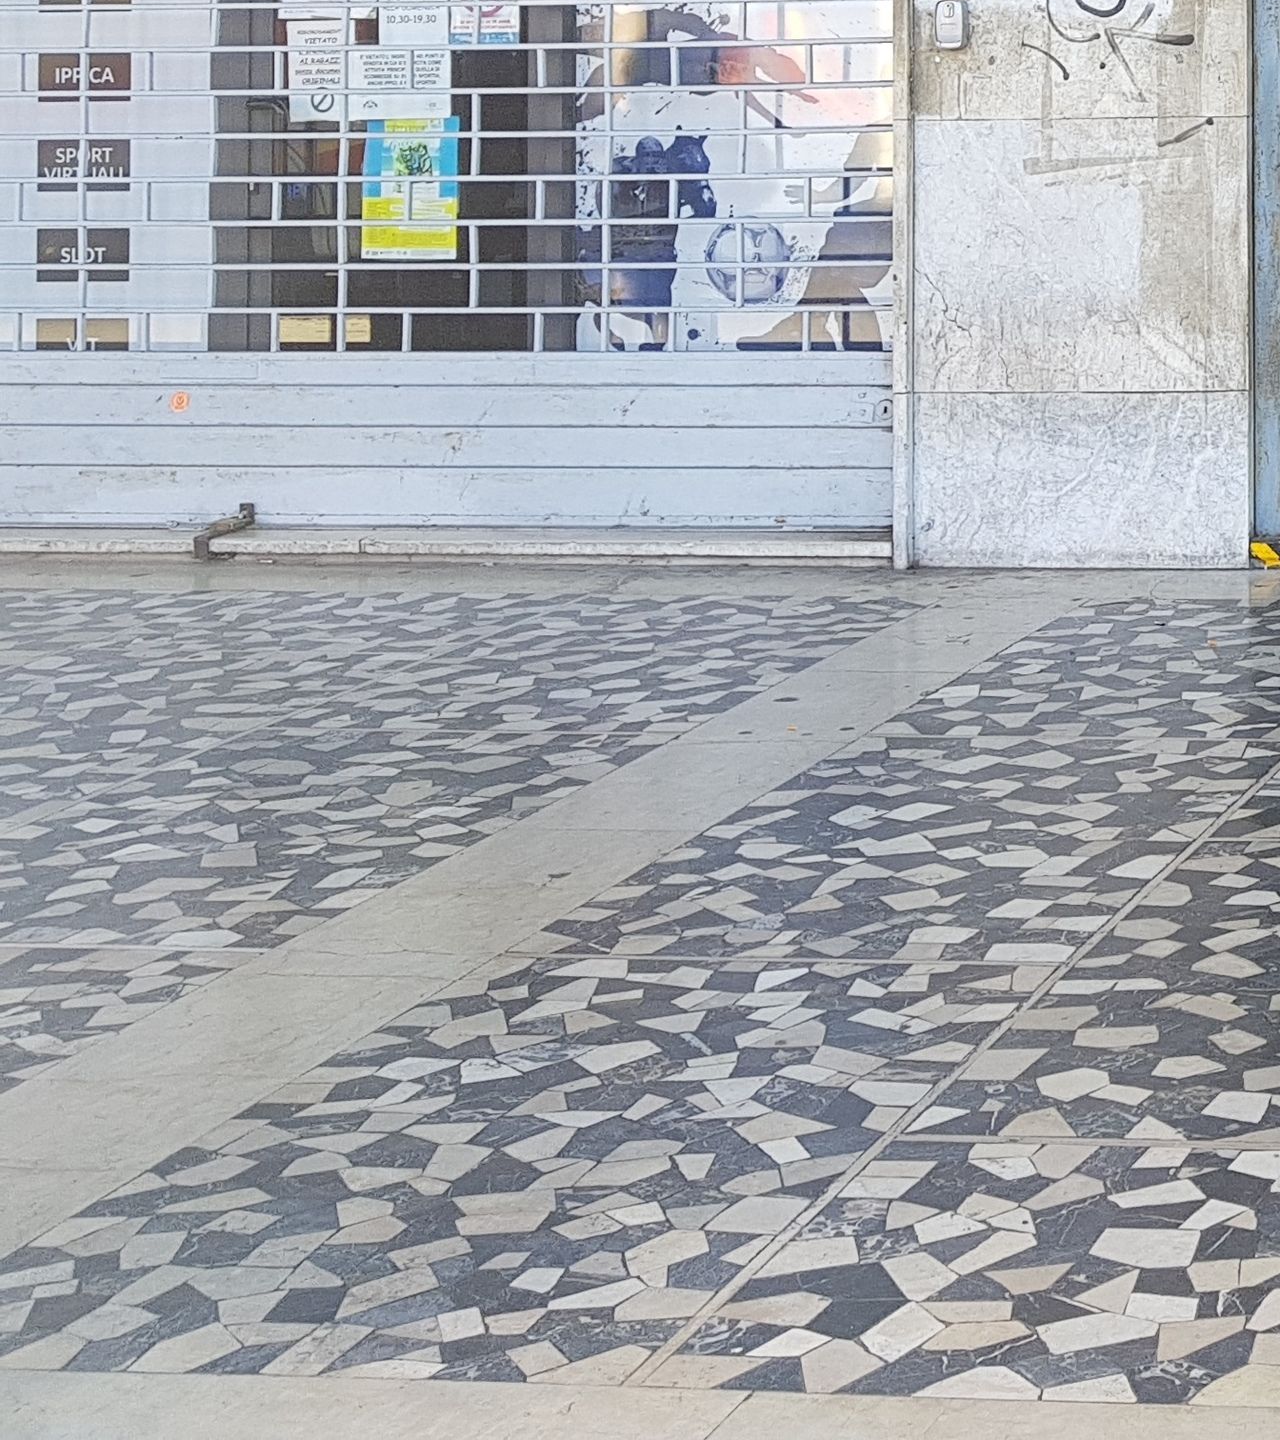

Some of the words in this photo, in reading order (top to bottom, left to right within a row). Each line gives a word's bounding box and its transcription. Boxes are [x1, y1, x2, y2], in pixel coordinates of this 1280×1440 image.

[386, 15, 437, 24] 10,30-19,30
[310, 56, 341, 65] RAGAZZ
[55, 67, 115, 84] IPPCA
[60, 247, 107, 263] SLOT
[66, 337, 99, 351] VT
